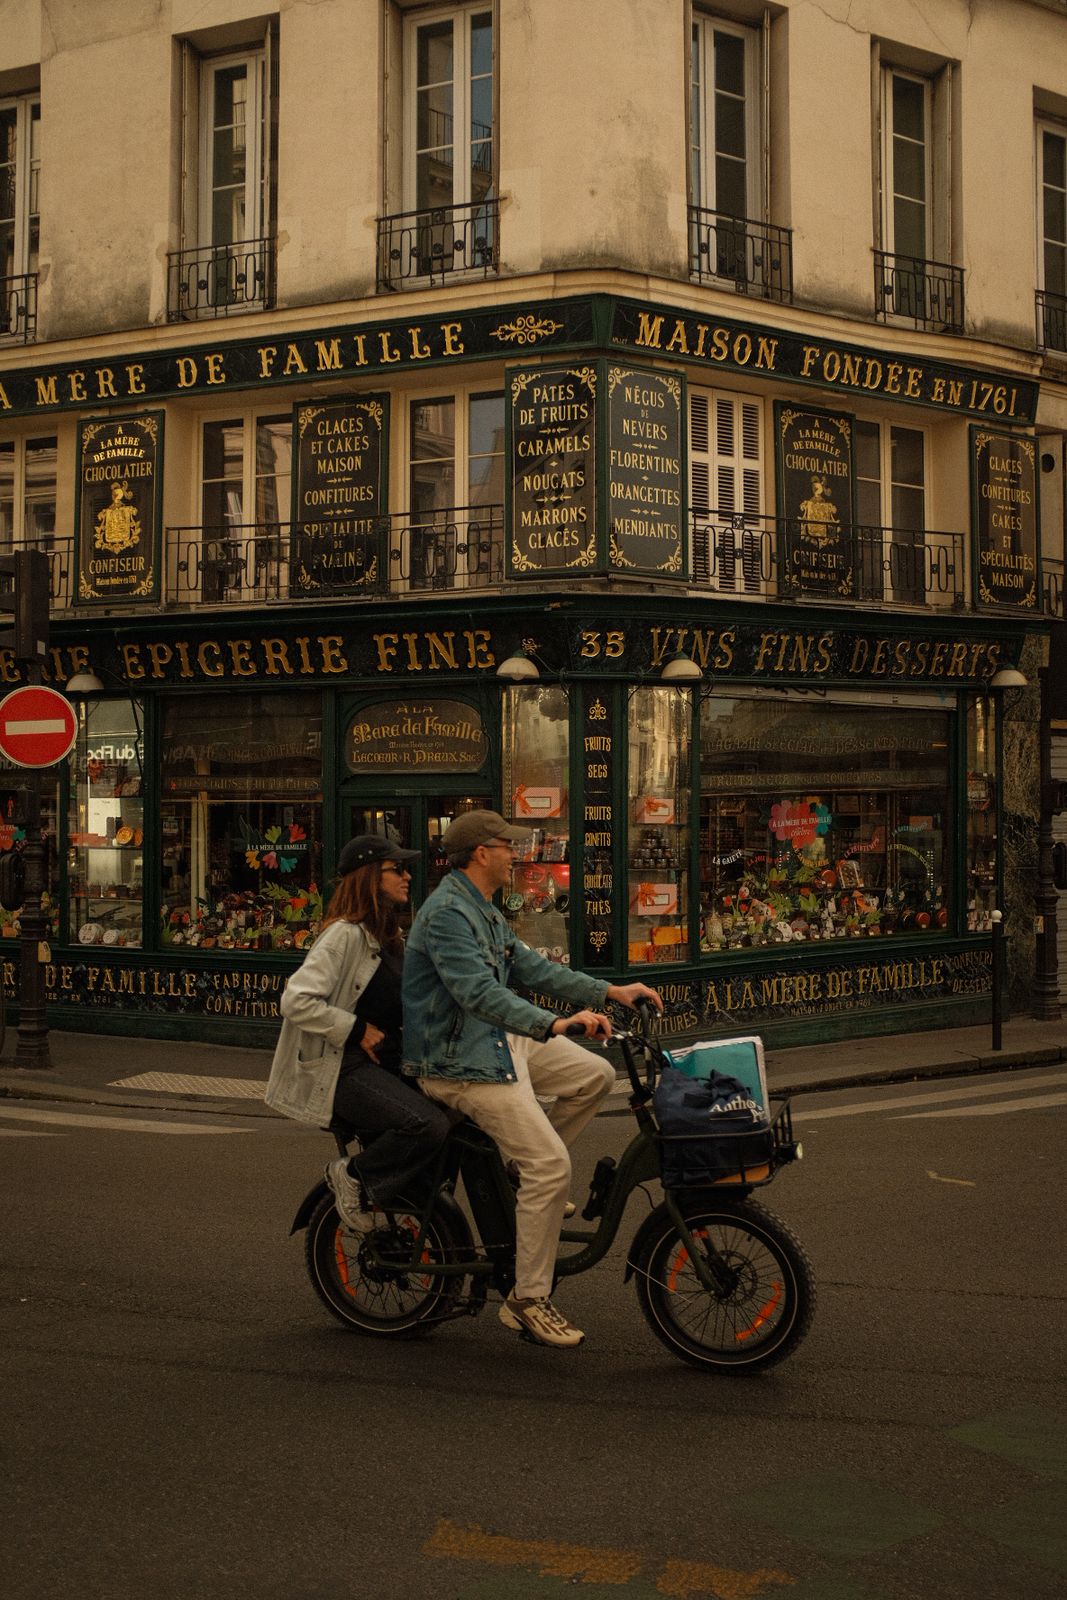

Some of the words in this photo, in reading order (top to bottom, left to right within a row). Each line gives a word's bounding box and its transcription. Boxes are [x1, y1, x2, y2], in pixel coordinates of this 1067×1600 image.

[175, 353, 227, 388] DE
[257, 321, 465, 378] FAMILLE
[635, 311, 779, 371] MAISON
[800, 345, 923, 398] FONDÉE
[931, 376, 964, 406] EN
[968, 380, 1017, 416] 1761
[533, 384, 575, 404] PÂTES
[625, 385, 665, 409] NÉGUS
[520, 409, 535, 426] DE
[541, 403, 589, 424] FRUITS
[640, 409, 649, 419] DE
[317, 417, 364, 436] GLACES
[622, 418, 669, 441] NEVERS
[93, 451, 106, 463] DE
[106, 447, 146, 459] FAMILLE
[100, 439, 113, 450] LA
[311, 440, 323, 455] ET
[327, 435, 370, 454] CAKES
[518, 435, 591, 457] CARAMELS
[805, 441, 841, 458] FAMILLE
[85, 461, 153, 482] CHOCOLATIER
[317, 455, 362, 475] MAISON
[610, 449, 681, 475] FLORENTINS
[785, 453, 849, 477] CHOCOLATIER
[989, 456, 1023, 475] GLACES
[523, 471, 586, 492] NOUGATS
[304, 485, 374, 506] CONFITURES
[609, 481, 681, 507] ORANGETTES
[982, 484, 1031, 505] CONFITURES
[521, 506, 588, 528] MARRONS
[992, 512, 1023, 531] CAKES
[528, 527, 580, 550] GLACÉS
[614, 517, 679, 541] MENDIANTS
[1002, 535, 1012, 549] ET
[88, 556, 145, 575] CONFISEUR
[992, 571, 1024, 588] MAISON
[373, 629, 496, 672] FINE
[580, 630, 626, 658] 35
[650, 626, 736, 670] VINS
[754, 632, 833, 673] FINS
[848, 637, 1001, 678] DESSERTS
[584, 736, 612, 752] FRUITS
[587, 764, 608, 778] SECS
[584, 806, 612, 821] FRUITS
[44, 964, 73, 989] DE
[86, 966, 198, 997] FAMILLE
[826, 969, 854, 998] DE
[857, 959, 945, 994] FAMILLE
[206, 995, 280, 1018] CONFITUR
